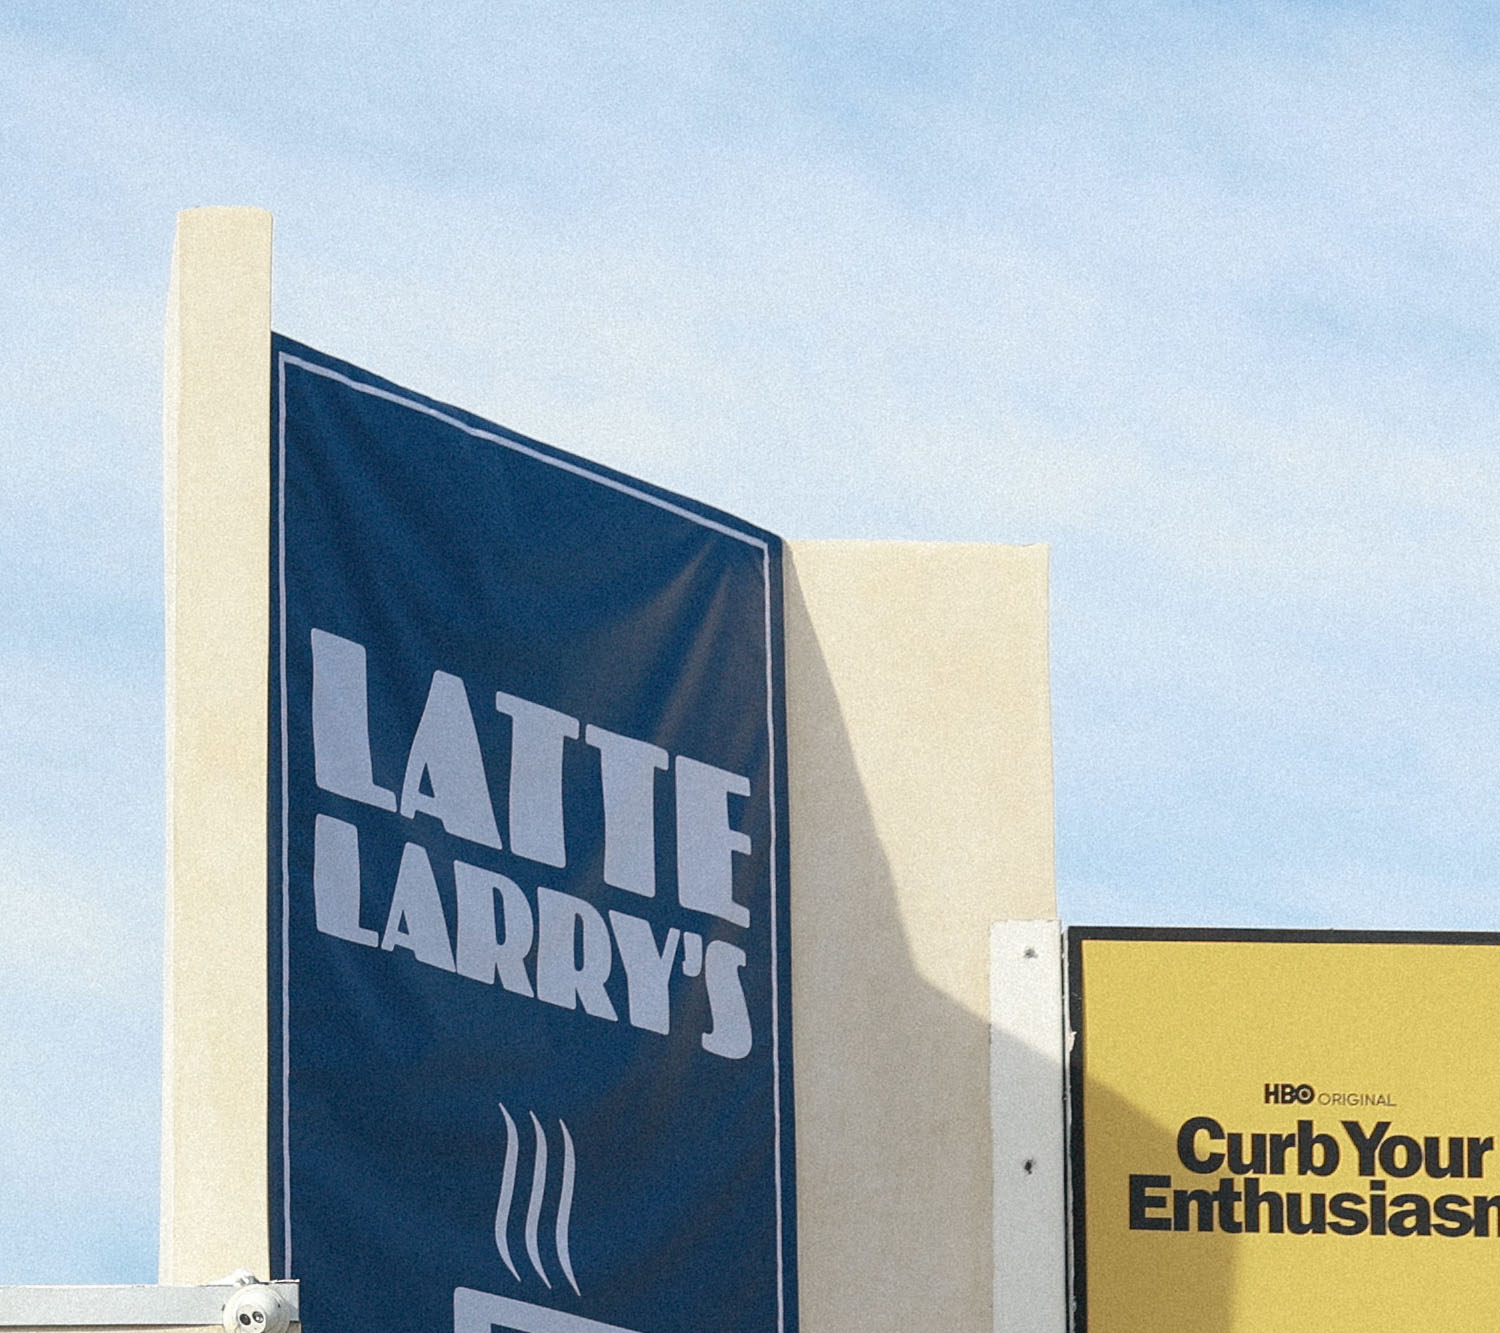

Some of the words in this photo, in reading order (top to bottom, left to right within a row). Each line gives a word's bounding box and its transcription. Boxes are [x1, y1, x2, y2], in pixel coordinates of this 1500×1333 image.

[311, 628, 751, 928] LATTE
[314, 813, 752, 1059] LARRY'S
[1177, 1116, 1340, 1176] Curb
[1341, 1120, 1494, 1178] Your
[1264, 1083, 1315, 1105] HBO
[1318, 1092, 1396, 1107] ORIGINAL
